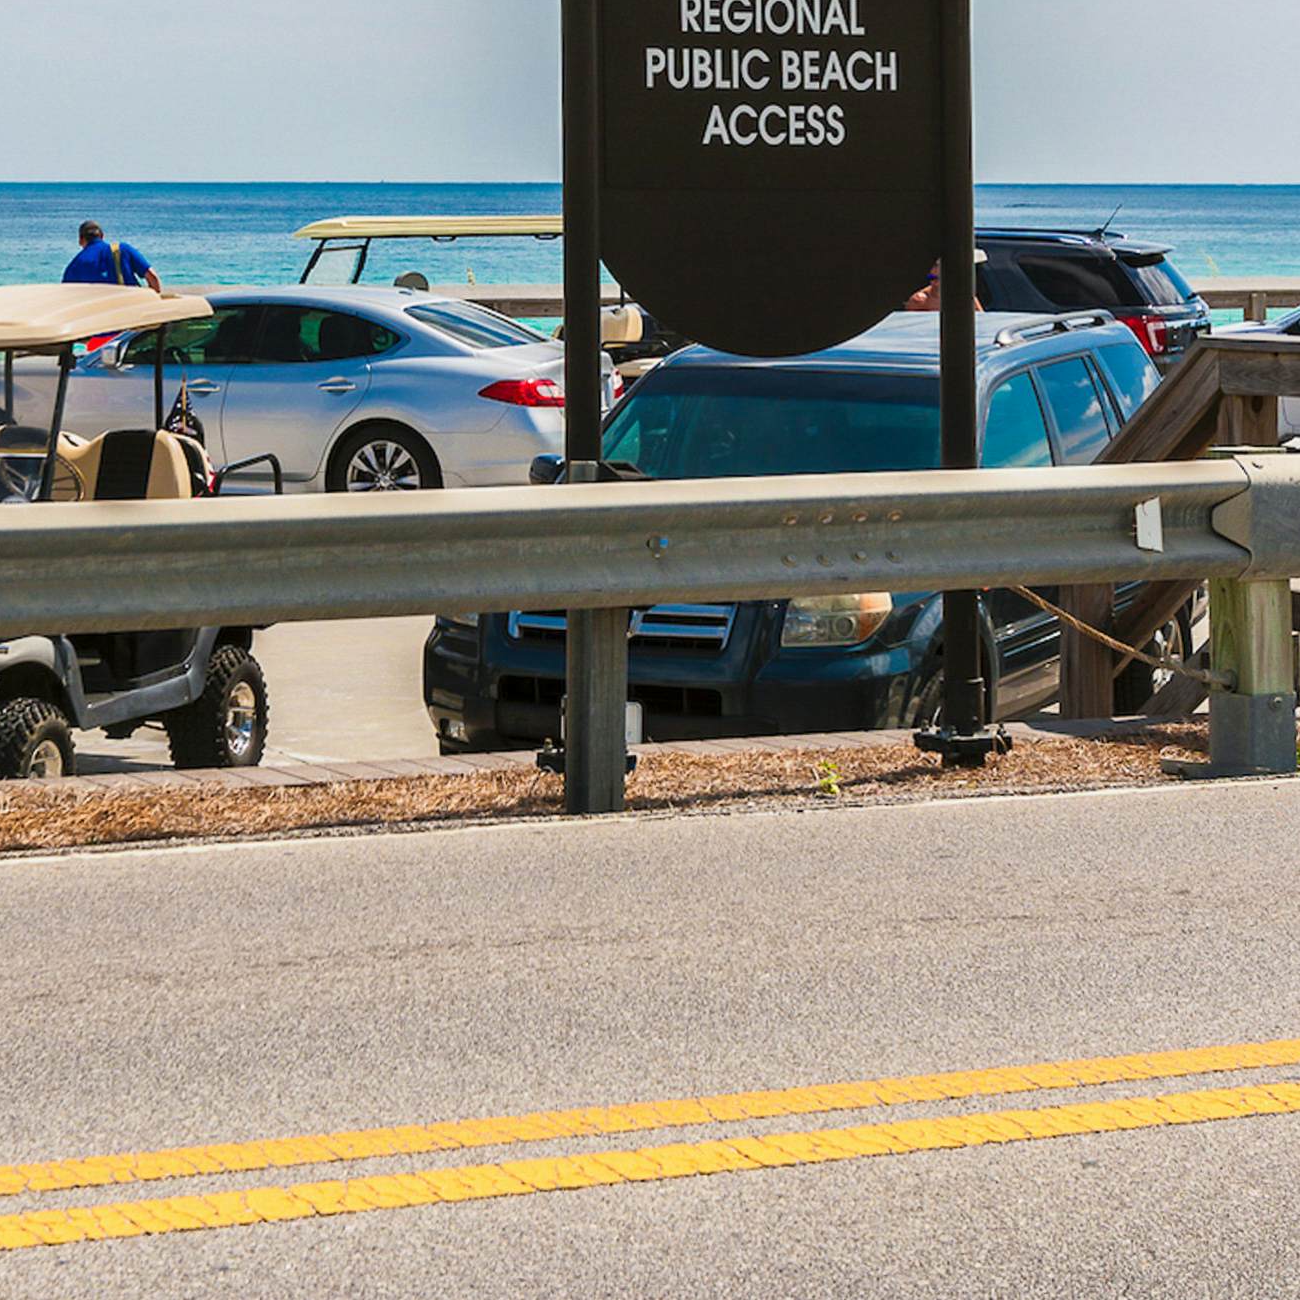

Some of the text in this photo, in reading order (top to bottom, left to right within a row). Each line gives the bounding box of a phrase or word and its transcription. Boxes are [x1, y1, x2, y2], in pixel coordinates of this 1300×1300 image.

[646, 48, 897, 90] PUBLIC BEACH
[703, 104, 845, 146] ACCESS
